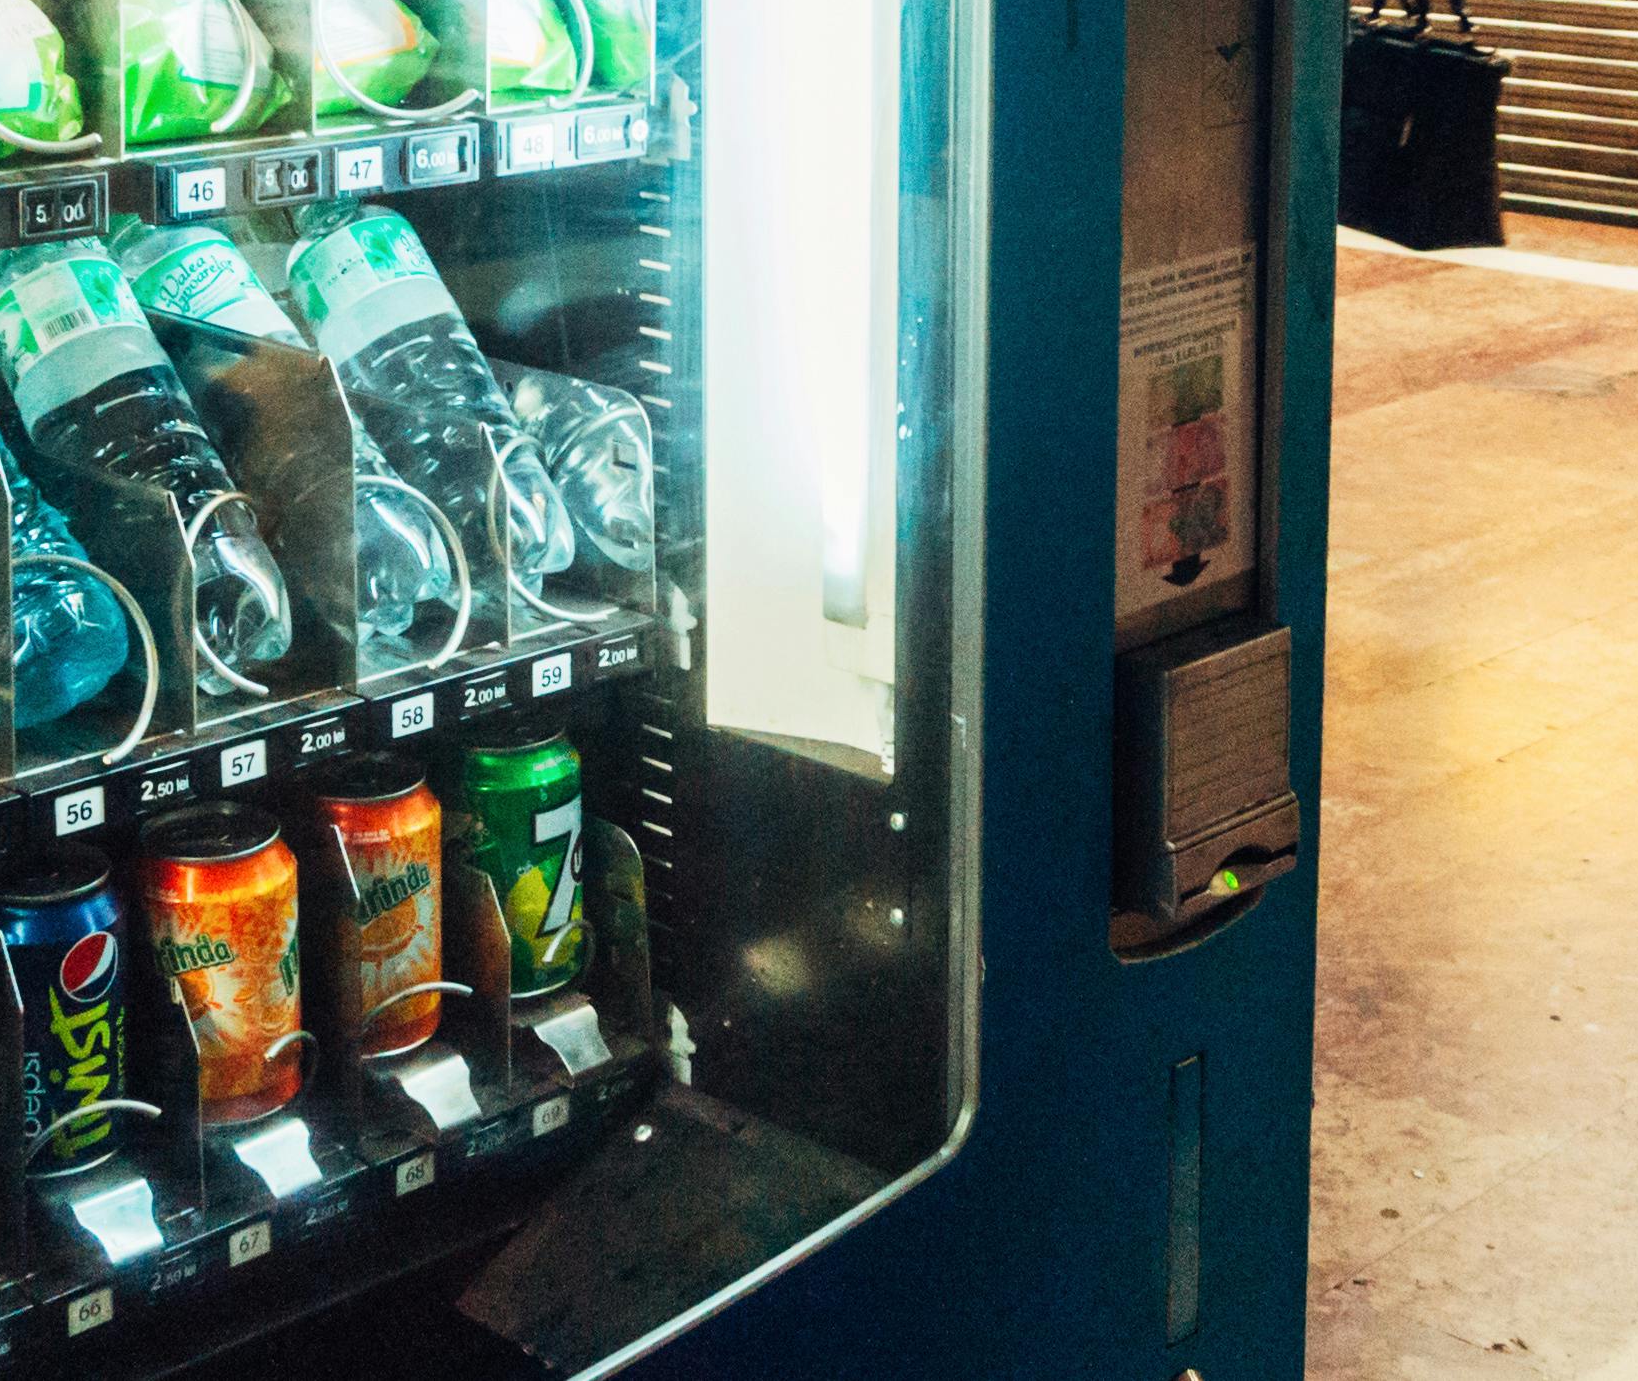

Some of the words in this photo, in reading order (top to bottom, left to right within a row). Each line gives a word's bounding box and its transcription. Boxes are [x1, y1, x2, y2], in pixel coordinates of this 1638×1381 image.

[521, 133, 545, 156] 48
[349, 158, 374, 183] 47
[188, 179, 215, 203] 46
[63, 201, 86, 223] 00
[541, 664, 562, 688] 59
[401, 705, 425, 729] 58
[231, 752, 256, 777] 57
[66, 800, 94, 826] 56
[403, 1163, 425, 1184] 68
[238, 1231, 260, 1255] 67
[78, 1297, 102, 1321] 66
